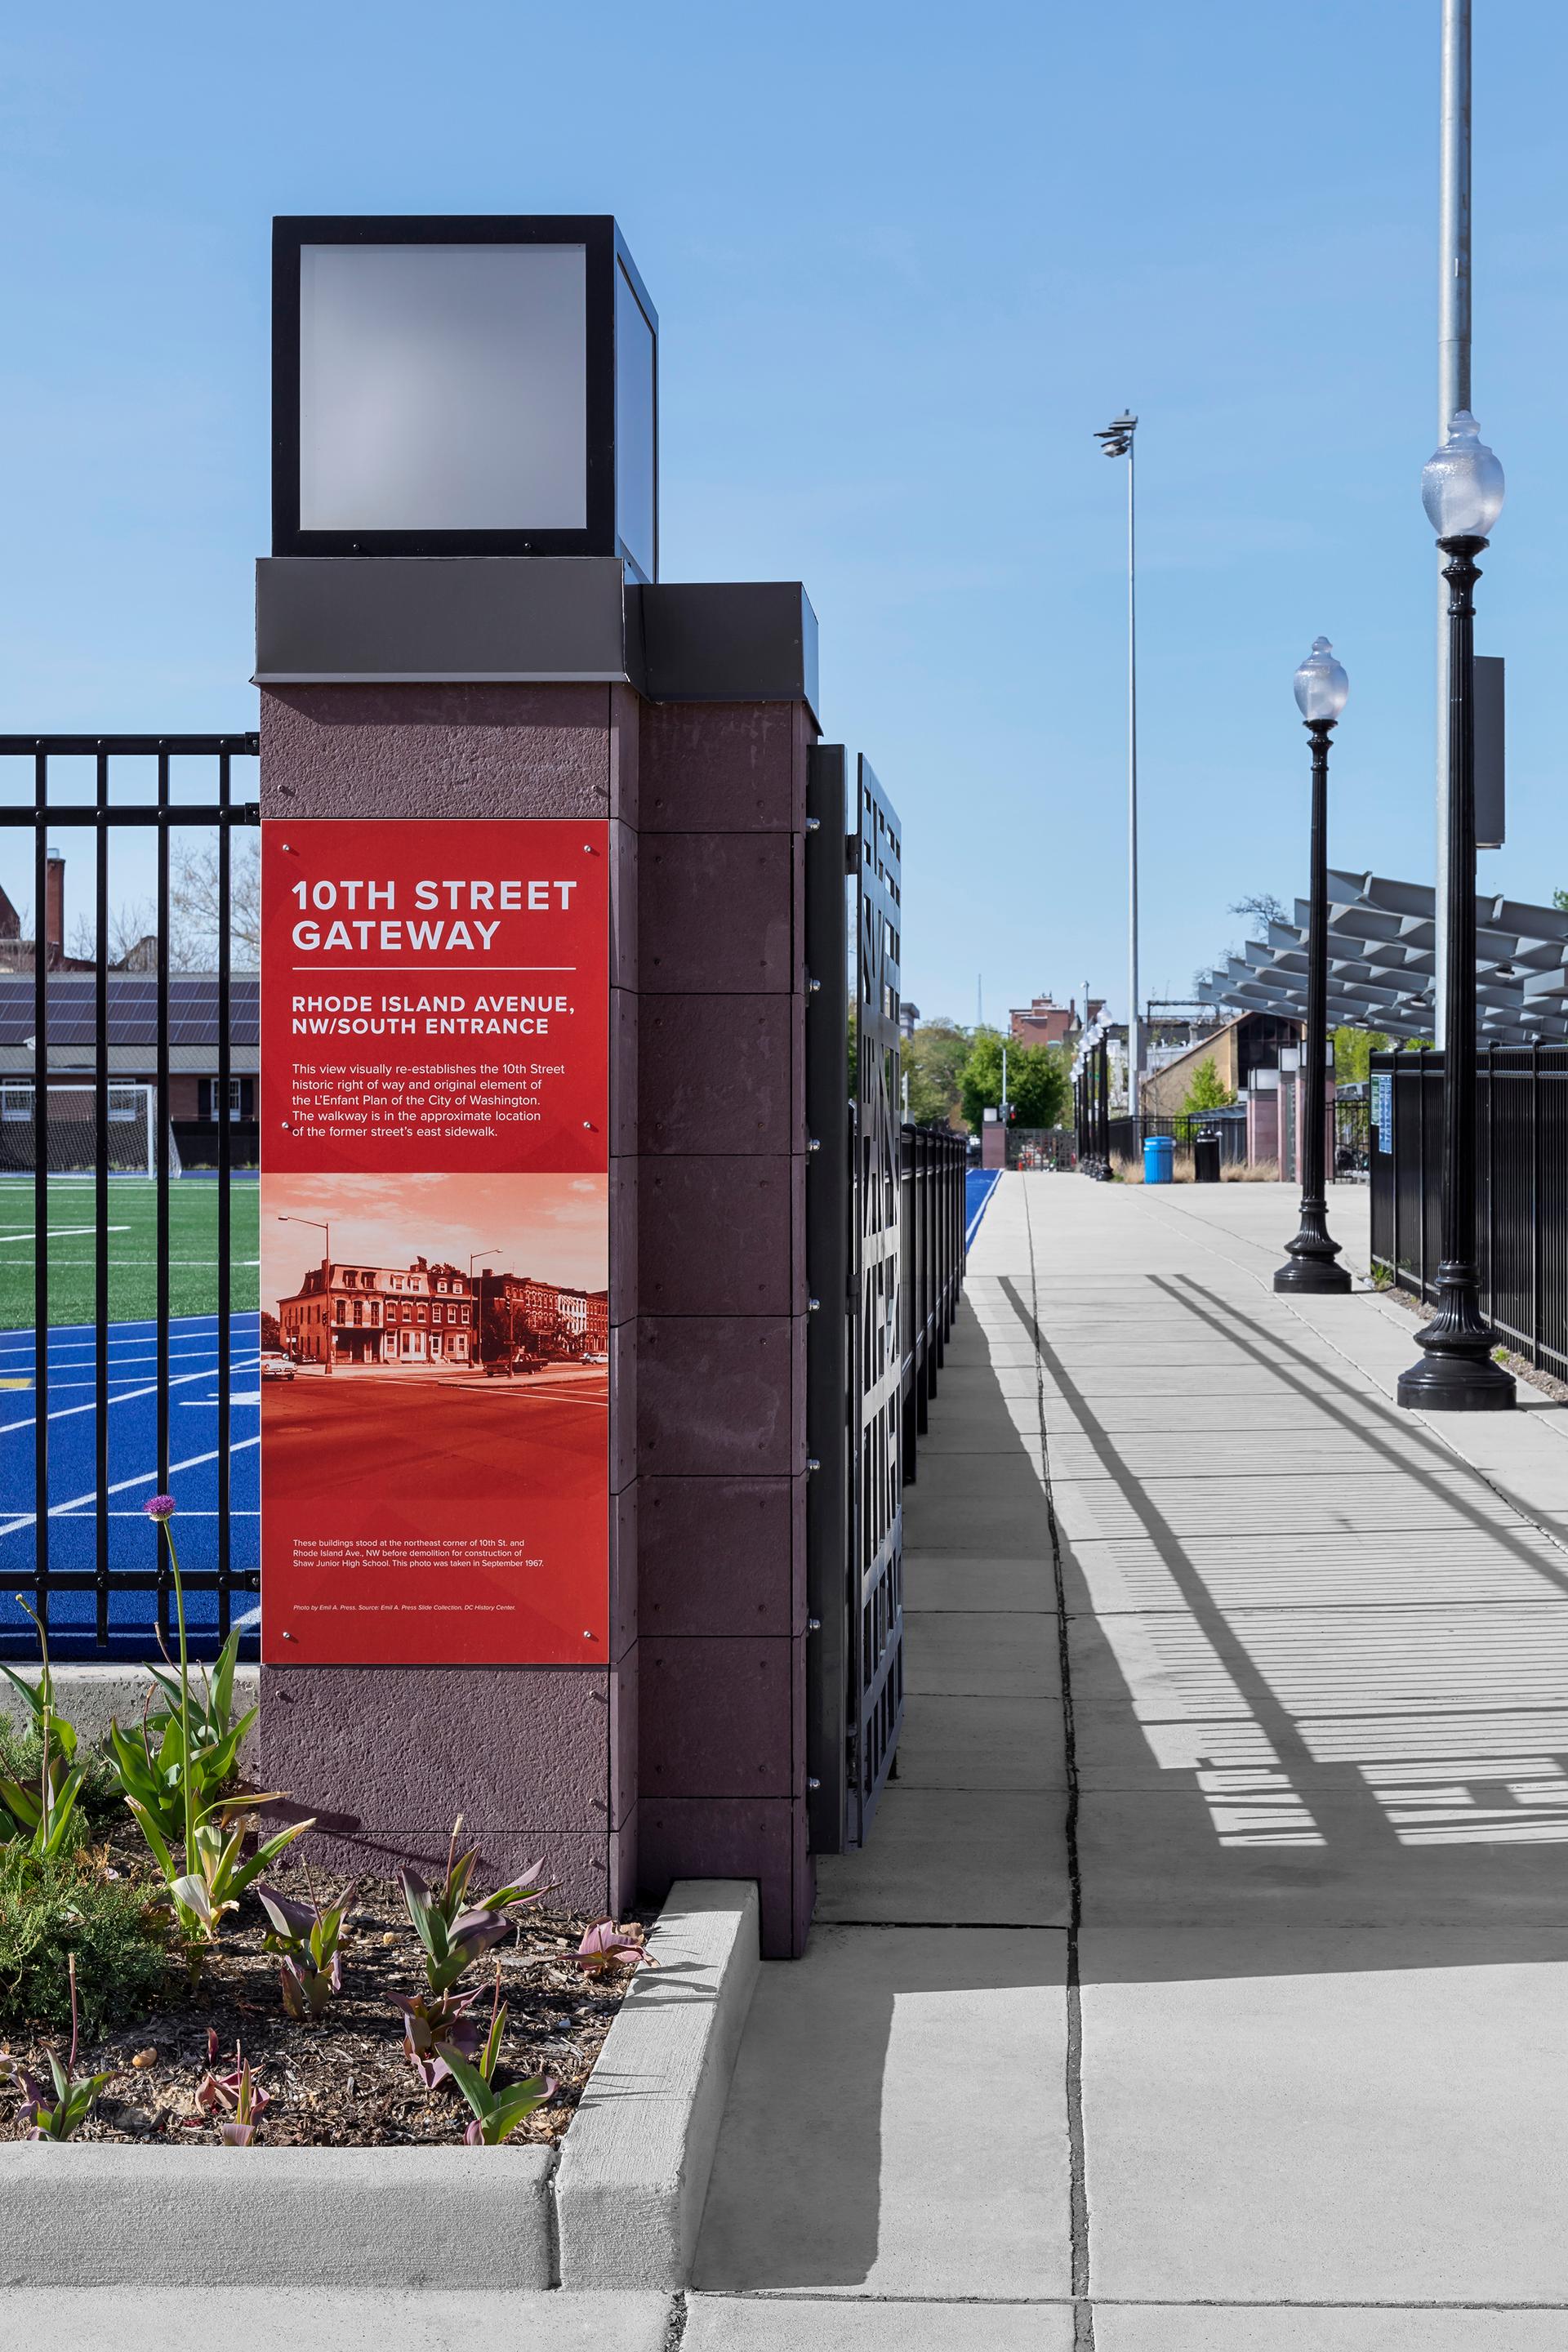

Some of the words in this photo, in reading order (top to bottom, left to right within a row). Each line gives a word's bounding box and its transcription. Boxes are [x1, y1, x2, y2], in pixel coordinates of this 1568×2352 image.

[292, 880, 394, 910] 10TH
[415, 880, 577, 910] STREET
[292, 920, 501, 951] GATEWAY
[292, 996, 372, 1012] RHODE
[382, 996, 465, 1012] ISLAND
[474, 996, 574, 1014] AVENUE,
[292, 1018, 416, 1034] NW/SOUTH
[426, 1018, 548, 1034] ENTRANCE
[292, 1064, 316, 1074] This
[319, 1064, 346, 1074] view
[350, 1064, 392, 1076] visually
[396, 1064, 476, 1074] re-establishes
[480, 1064, 498, 1074] the
[502, 1063, 526, 1074] 10th
[530, 1063, 565, 1074] Street
[292, 1080, 333, 1089] historic
[337, 1080, 363, 1092] right
[367, 1080, 379, 1089] of
[382, 1082, 405, 1092] way
[408, 1080, 430, 1089] and
[434, 1080, 476, 1092] original
[480, 1080, 527, 1089] element
[531, 1080, 542, 1089] of
[292, 1095, 310, 1105] the
[363, 1095, 387, 1105] Plan
[391, 1095, 403, 1105] of
[406, 1095, 425, 1105] the
[429, 1095, 452, 1107] City
[455, 1095, 466, 1105] of
[470, 1095, 540, 1107] Washington.
[292, 1111, 314, 1120] The
[318, 1111, 368, 1123] walkway
[372, 1111, 381, 1120] is
[385, 1111, 394, 1120] in
[398, 1111, 416, 1120] the
[421, 1111, 492, 1123] approximate
[496, 1111, 541, 1120] location
[292, 1126, 304, 1137] of
[307, 1126, 326, 1137] the
[329, 1126, 368, 1137] former
[416, 1127, 441, 1136] east
[445, 1126, 497, 1136] sidewalk.
[319, 1539, 354, 1548] buildings
[345, 1549, 363, 1557] Ave.,
[342, 1560, 360, 1568] High
[409, 1560, 431, 1568] photo
[482, 1560, 523, 1568] September
